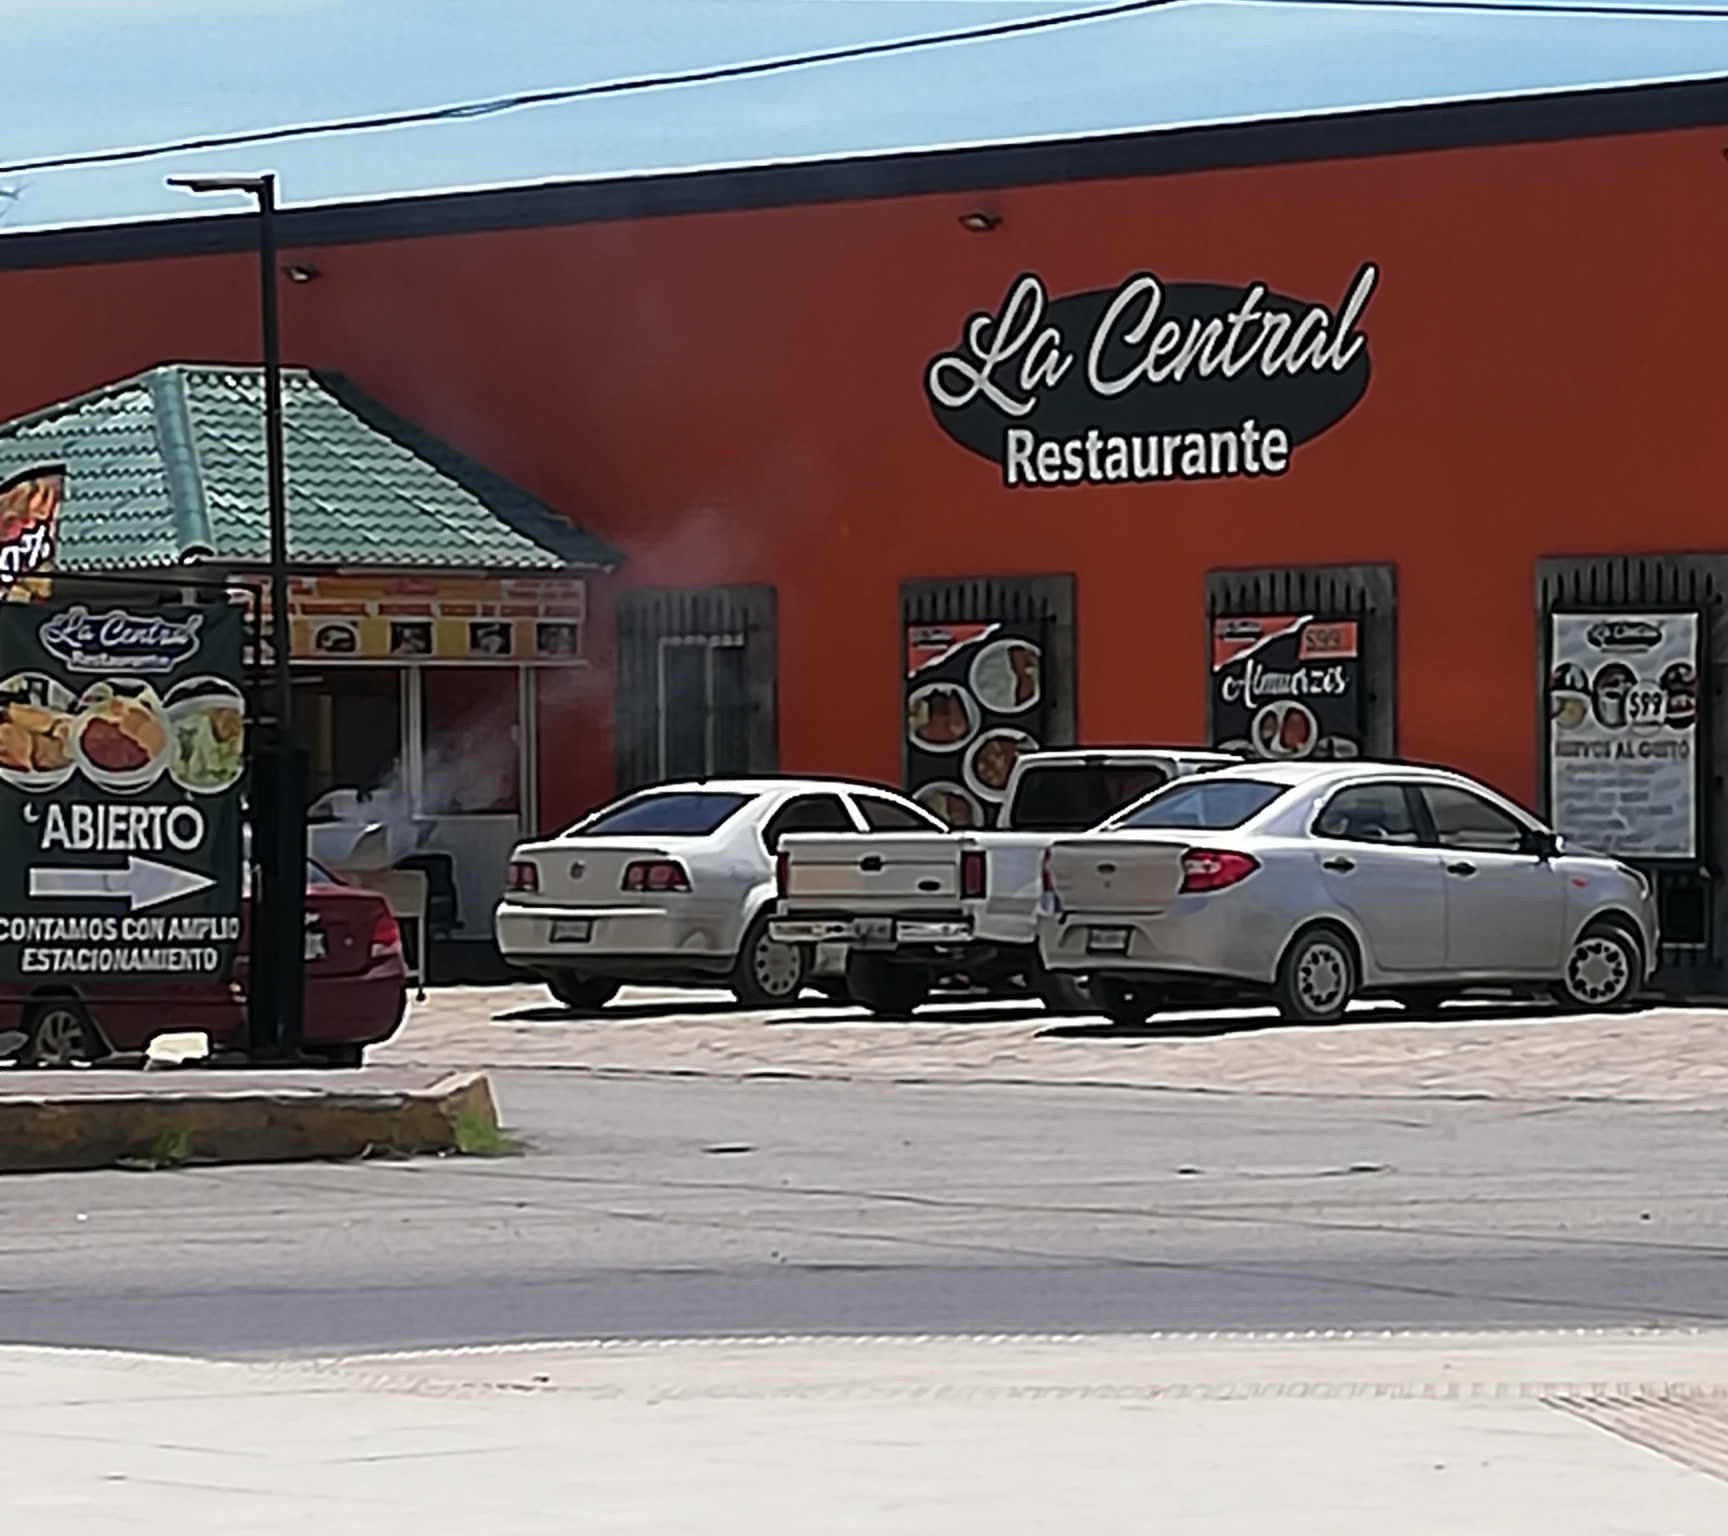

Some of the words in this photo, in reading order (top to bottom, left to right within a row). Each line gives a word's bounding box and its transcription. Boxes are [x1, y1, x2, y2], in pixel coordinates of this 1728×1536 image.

[929, 277, 1073, 416] La
[1088, 263, 1378, 395] Central
[1005, 419, 1289, 484] Restaurante
[46, 613, 95, 648] La
[100, 615, 200, 647] Central
[41, 803, 205, 851] ABIERTO
[0, 917, 118, 941] CONTAMOS
[121, 917, 166, 941] CON
[167, 916, 241, 941] AMPLIO
[21, 947, 219, 972] ESTACIONAMIENTO
